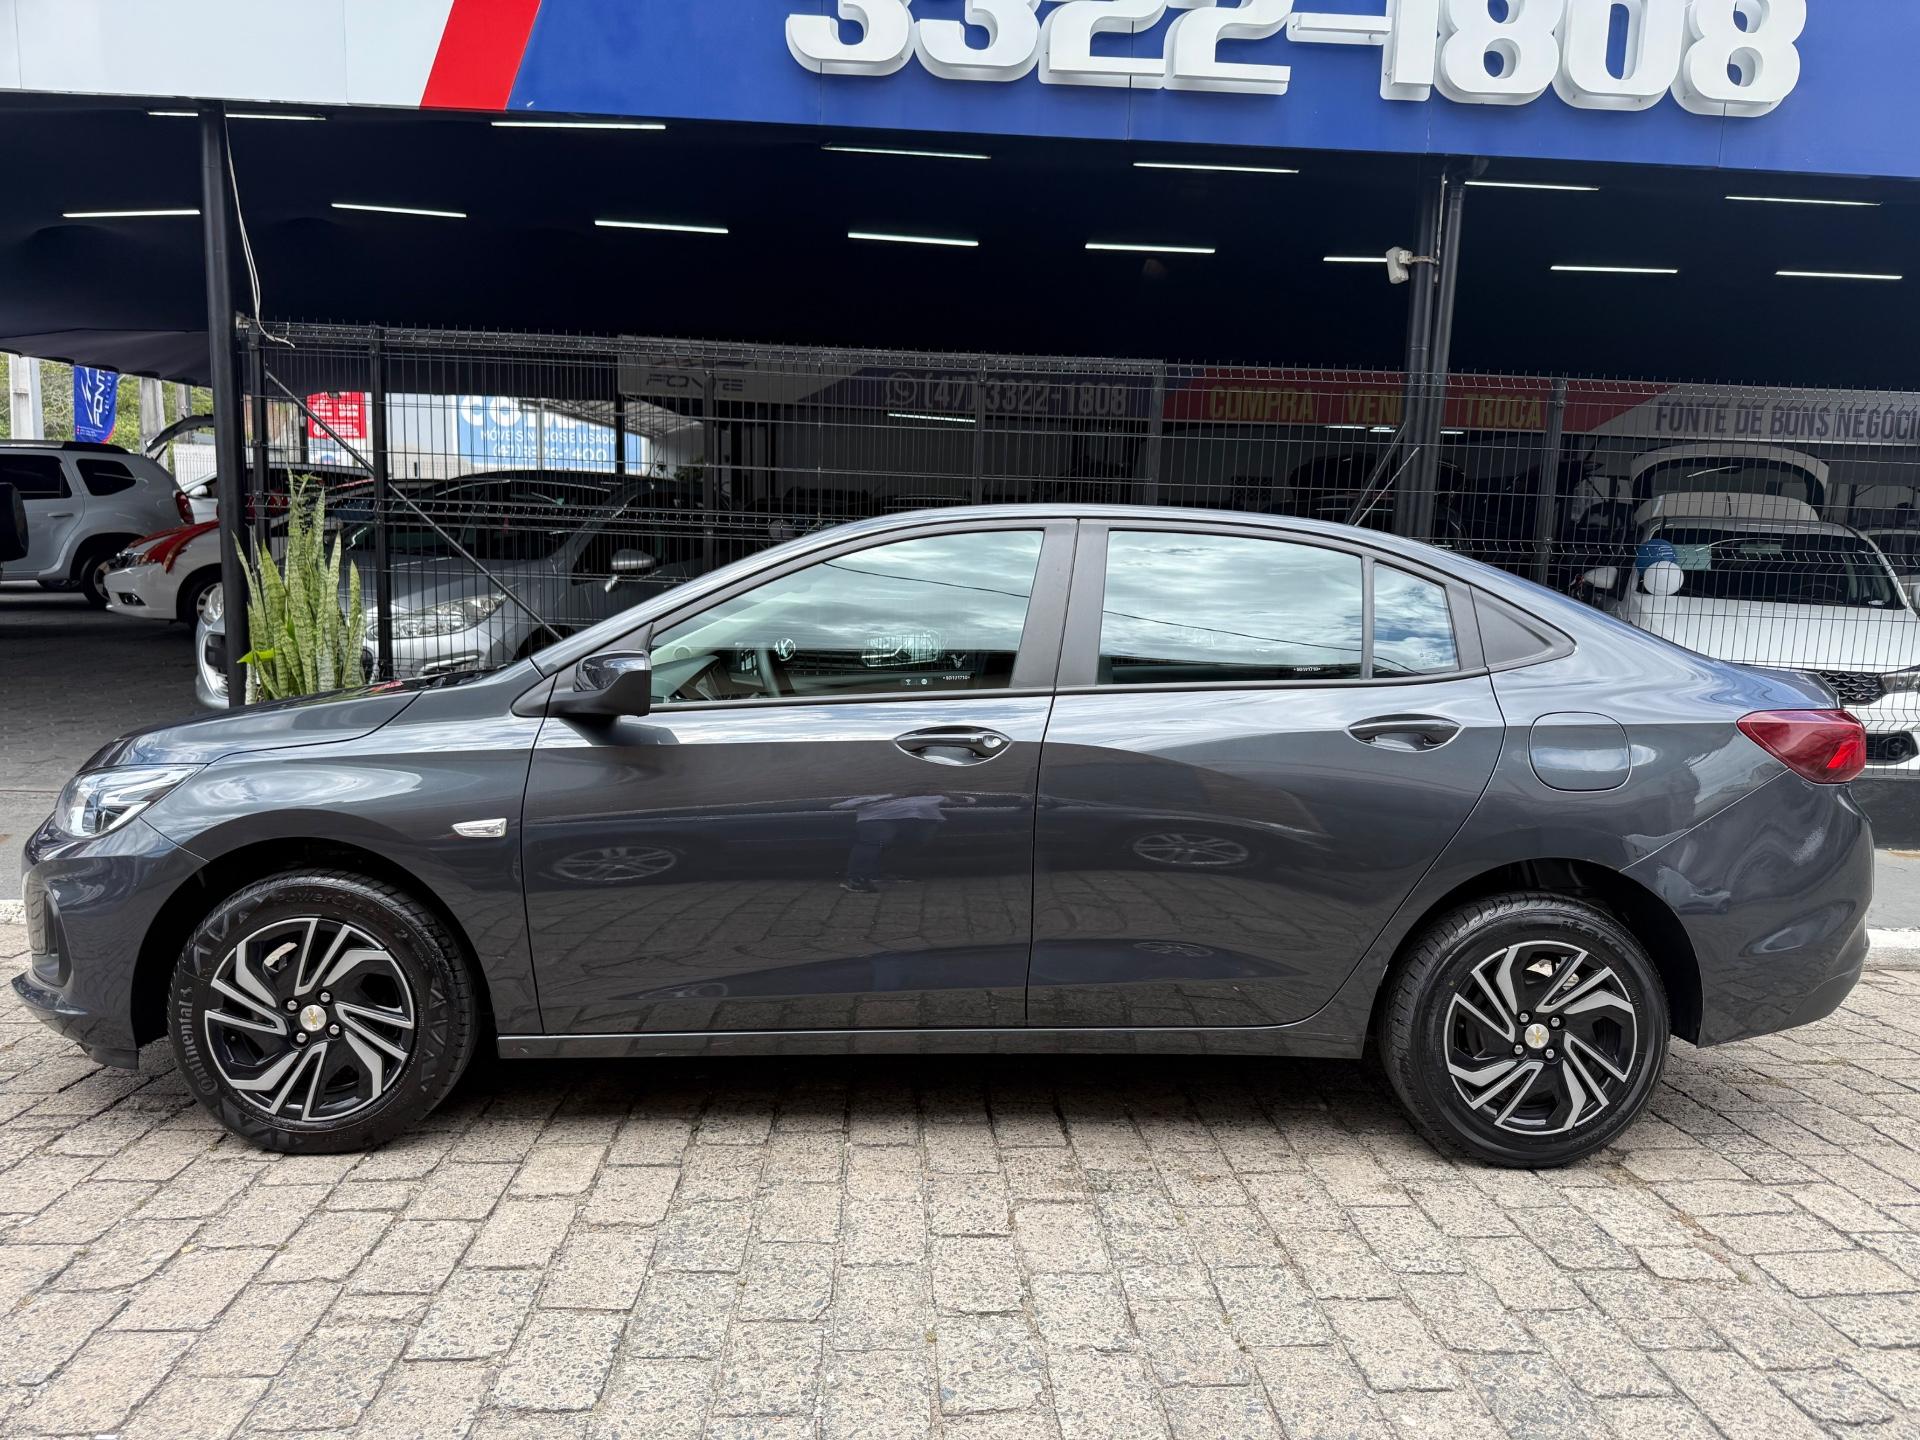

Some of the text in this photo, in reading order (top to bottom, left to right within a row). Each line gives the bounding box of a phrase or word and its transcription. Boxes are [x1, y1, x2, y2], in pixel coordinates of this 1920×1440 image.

[784, 0, 1807, 117] 3322-1808
[93, 369, 106, 428] FONT
[646, 374, 747, 392] FOE
[924, 372, 1128, 416] (47) 3322-1808
[1209, 385, 1314, 420] COMPRA
[1462, 391, 1543, 428] TROCA
[1655, 400, 1729, 434] FONTE
[1734, 403, 1764, 435] DE
[1770, 404, 1830, 437] BONS
[528, 430, 567, 443] NVOS
[578, 432, 618, 445] USADO
[178, 998, 217, 1096] Continental
